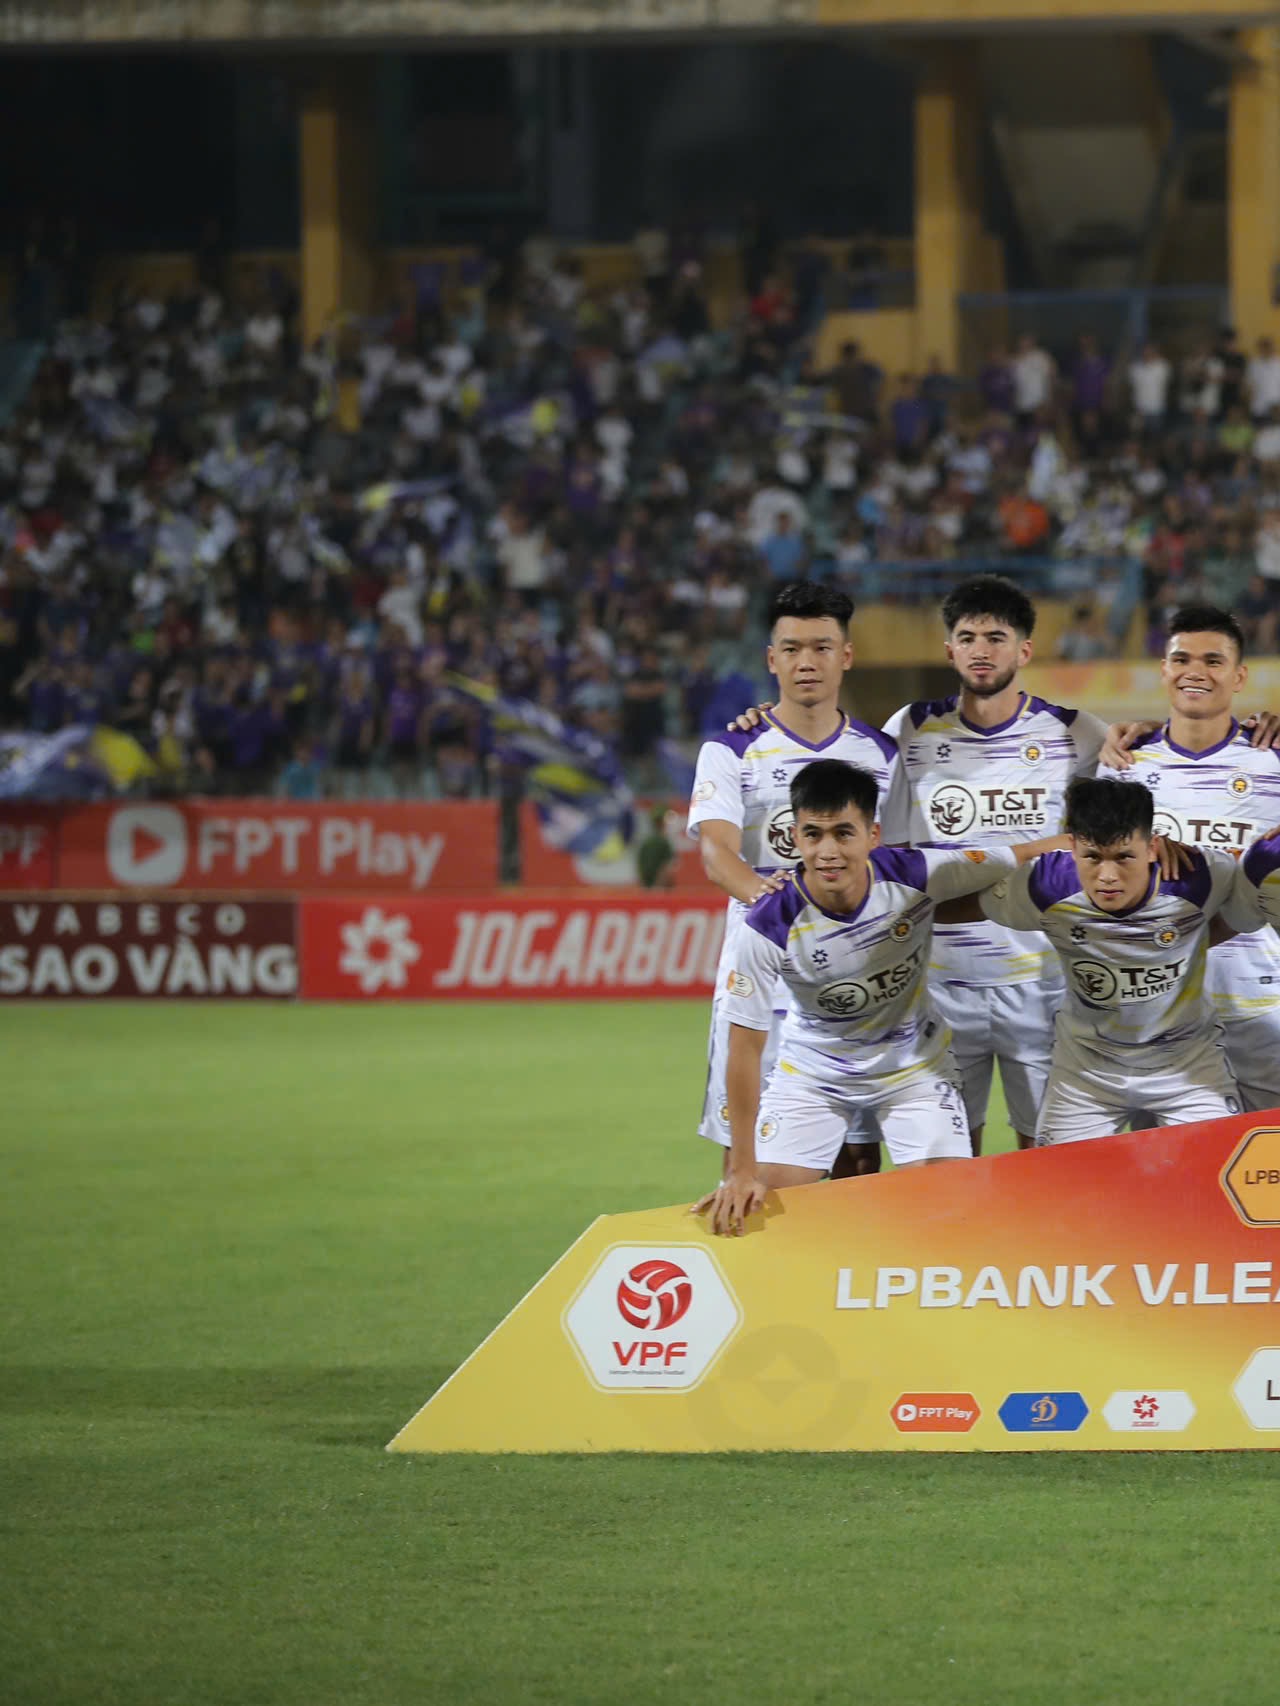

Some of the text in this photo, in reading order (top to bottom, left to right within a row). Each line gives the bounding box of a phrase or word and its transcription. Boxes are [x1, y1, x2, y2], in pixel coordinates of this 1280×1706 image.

[980, 787, 1046, 812] T&T
[981, 812, 1045, 827] HOMES
[1187, 819, 1253, 845] T&T
[198, 816, 445, 890] FPT Play
[0, 933, 297, 994] SAO VÀNG
[867, 944, 923, 991] T&T
[1120, 958, 1186, 986] T&T
[1121, 980, 1176, 999] HOME
[835, 1264, 1118, 1309] LPBANK
[612, 1341, 688, 1367] VPF
[918, 1407, 974, 1421] FPT Play
